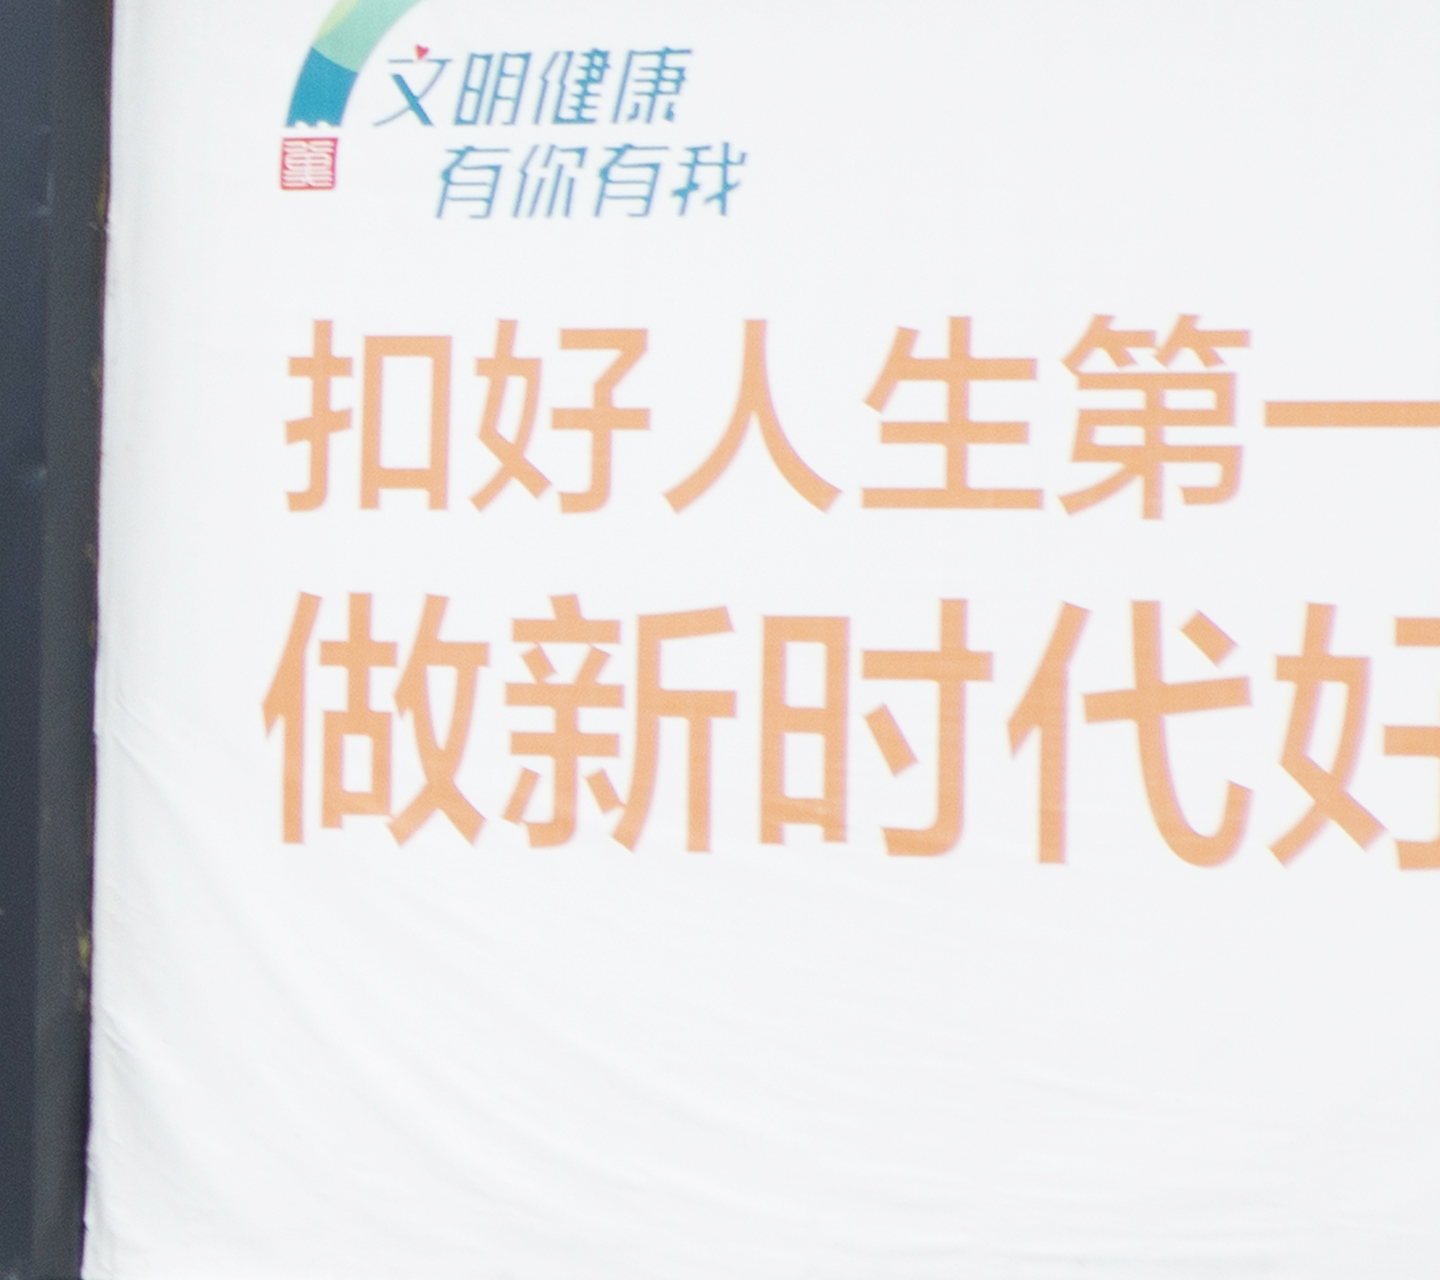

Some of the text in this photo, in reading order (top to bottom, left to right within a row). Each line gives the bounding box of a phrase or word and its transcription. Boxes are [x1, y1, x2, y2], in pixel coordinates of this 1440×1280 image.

[374, 44, 693, 127] 文明健康
[436, 141, 747, 220] 有你有我
[285, 315, 1440, 519] 扣好人生第一
